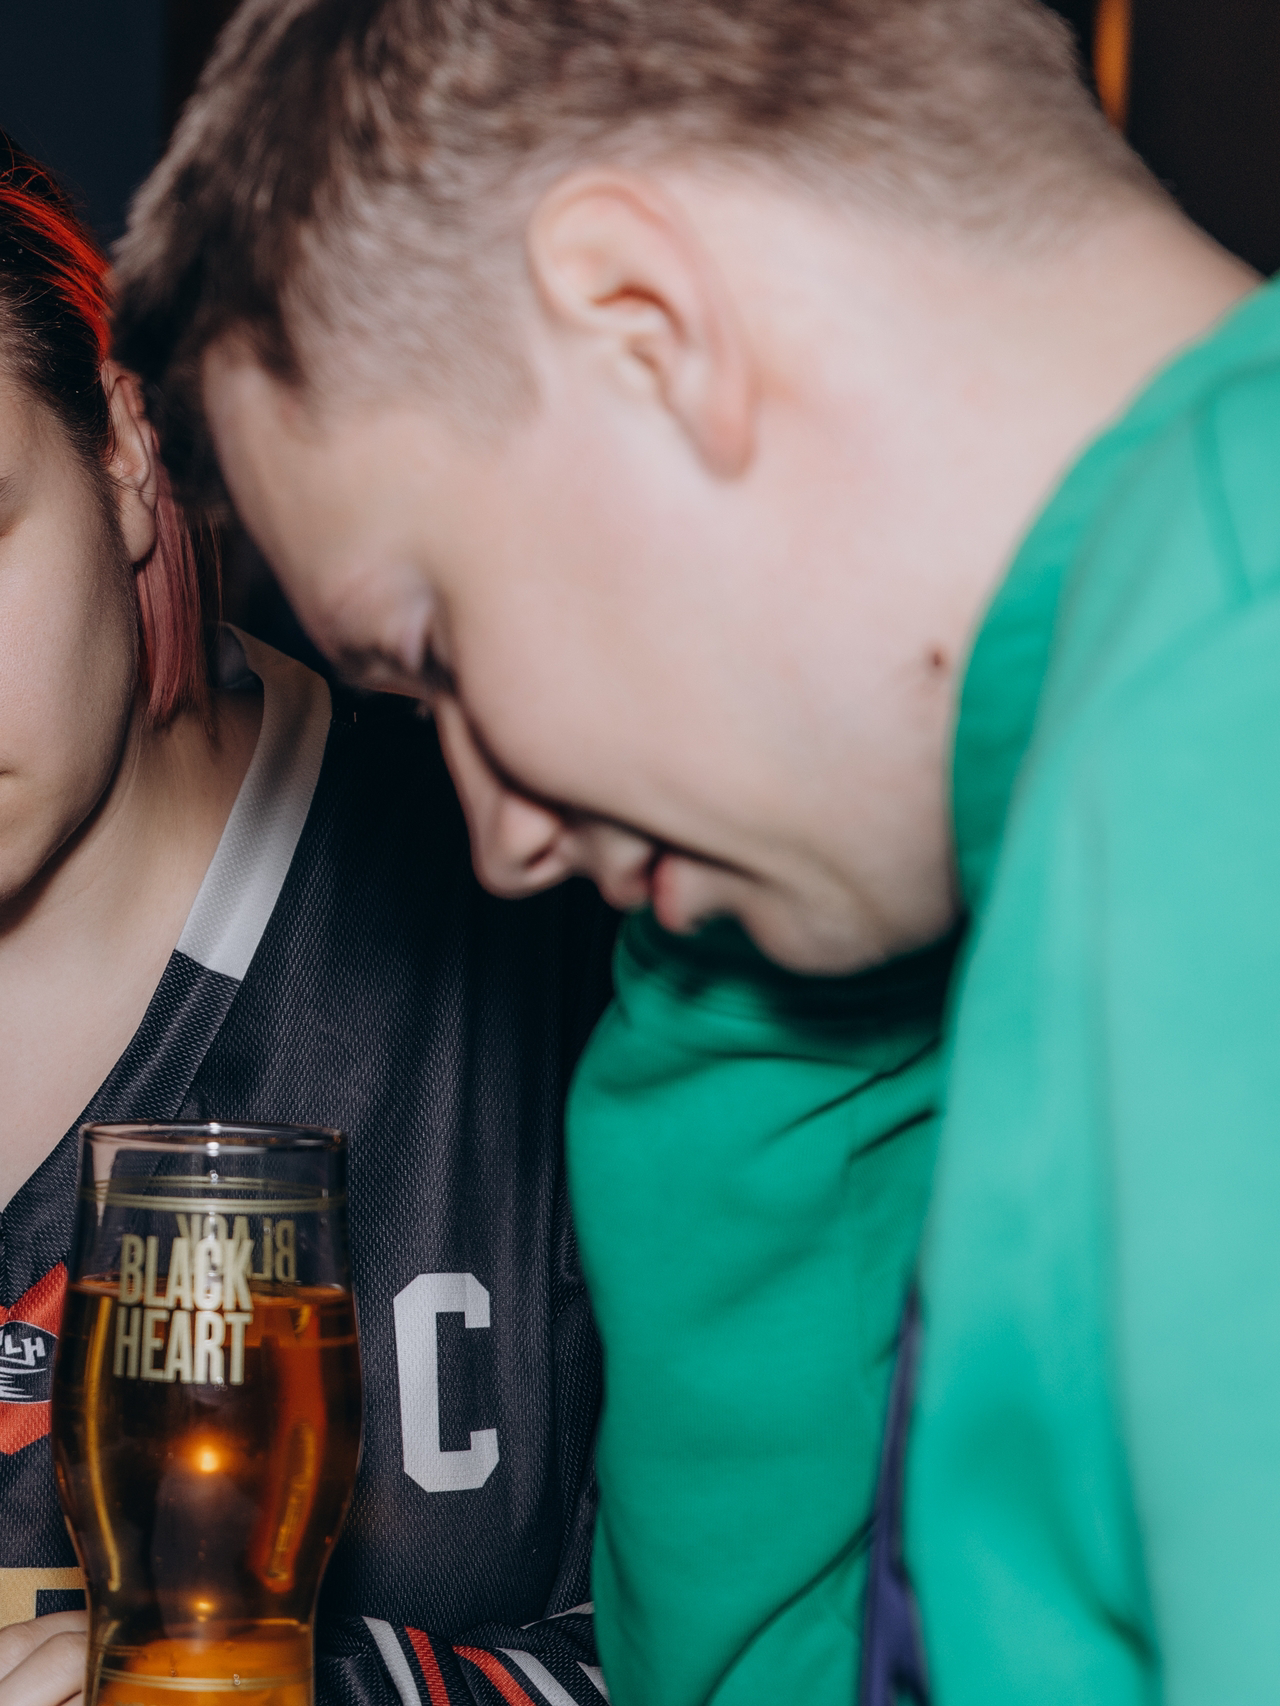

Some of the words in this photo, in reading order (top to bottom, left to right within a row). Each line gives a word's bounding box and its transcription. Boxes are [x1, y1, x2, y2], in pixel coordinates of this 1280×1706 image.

[120, 1233, 253, 1311] BLACK
[113, 1306, 253, 1386] HEART
[393, 1272, 500, 1493] C
